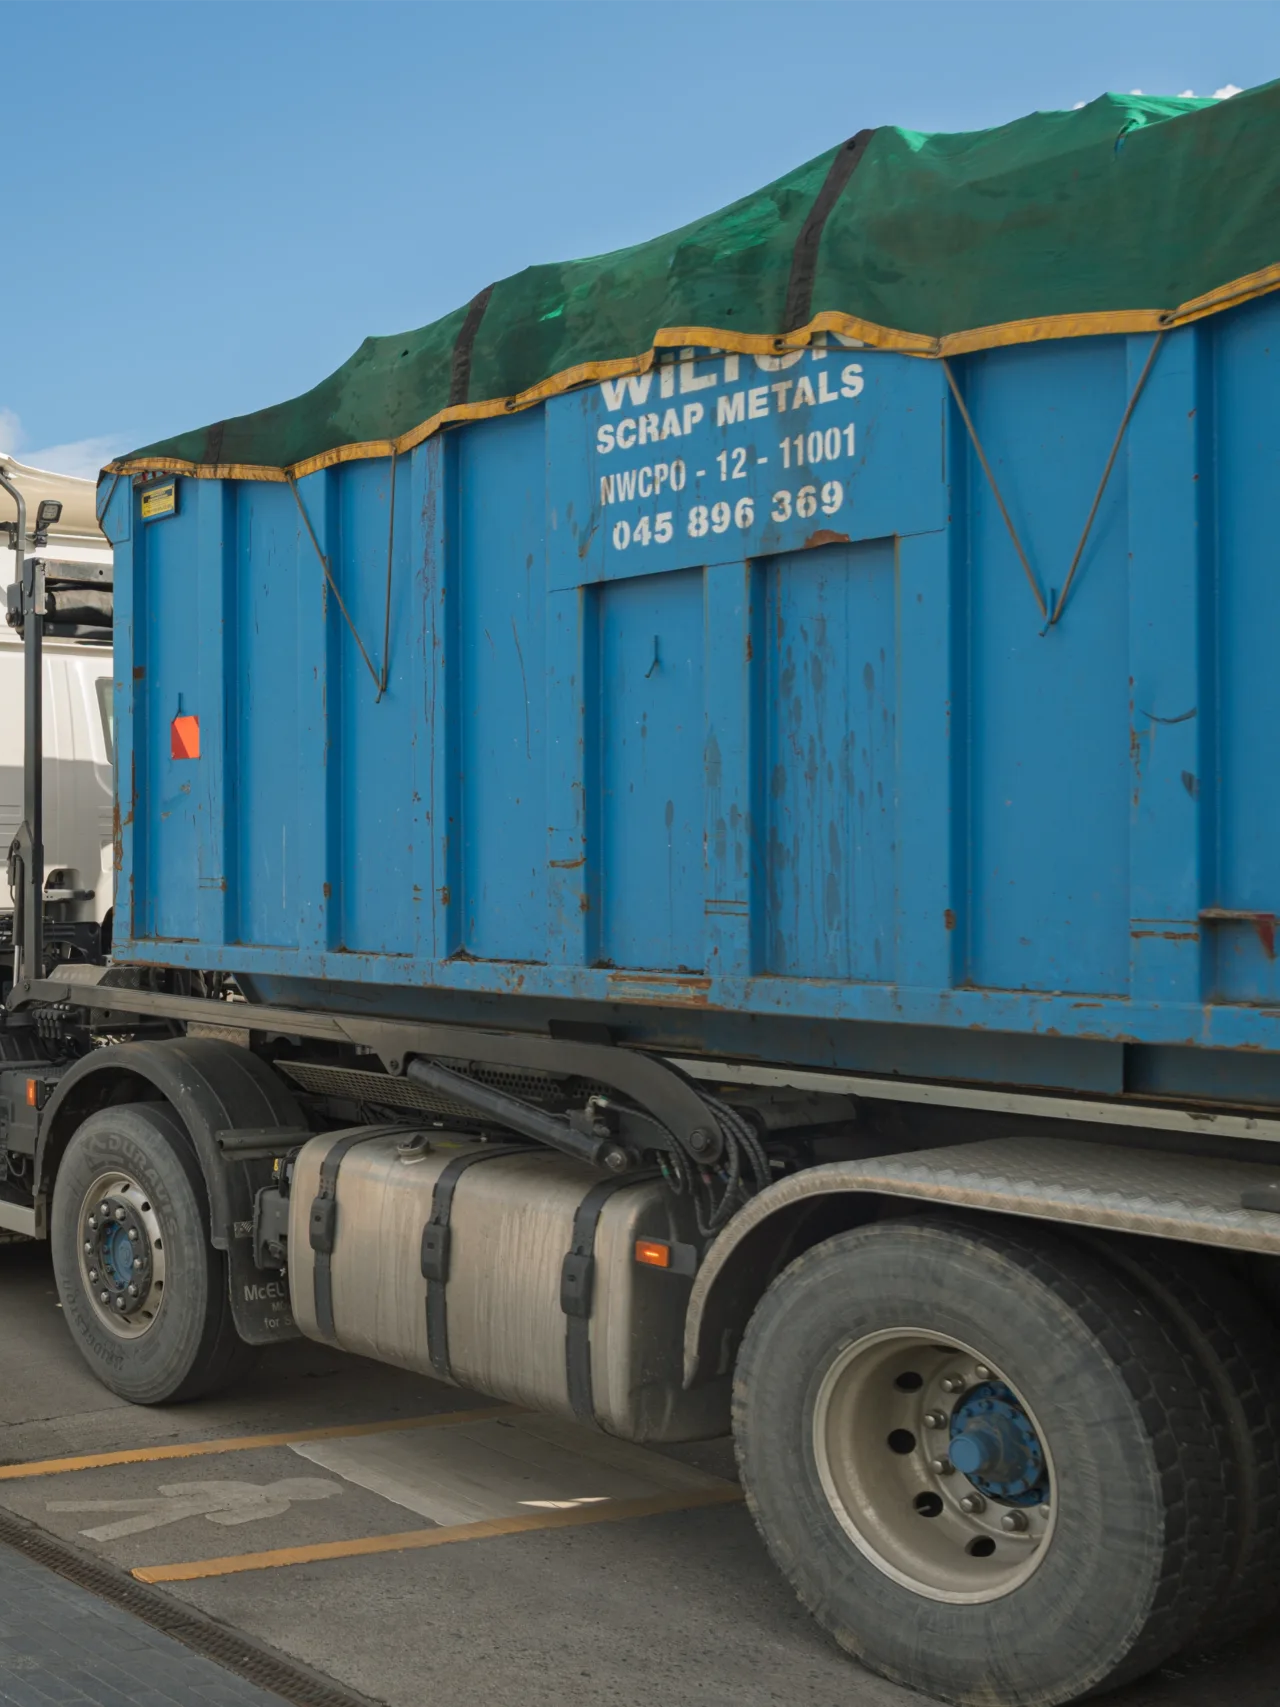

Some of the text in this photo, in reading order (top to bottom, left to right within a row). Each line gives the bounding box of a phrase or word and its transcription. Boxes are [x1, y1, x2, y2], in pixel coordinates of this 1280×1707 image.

[596, 363, 864, 454] SCRAP METALS
[600, 331, 864, 412] WILT
[716, 447, 747, 482] 12
[779, 423, 855, 468] 11001
[612, 480, 844, 550] 045 896 369
